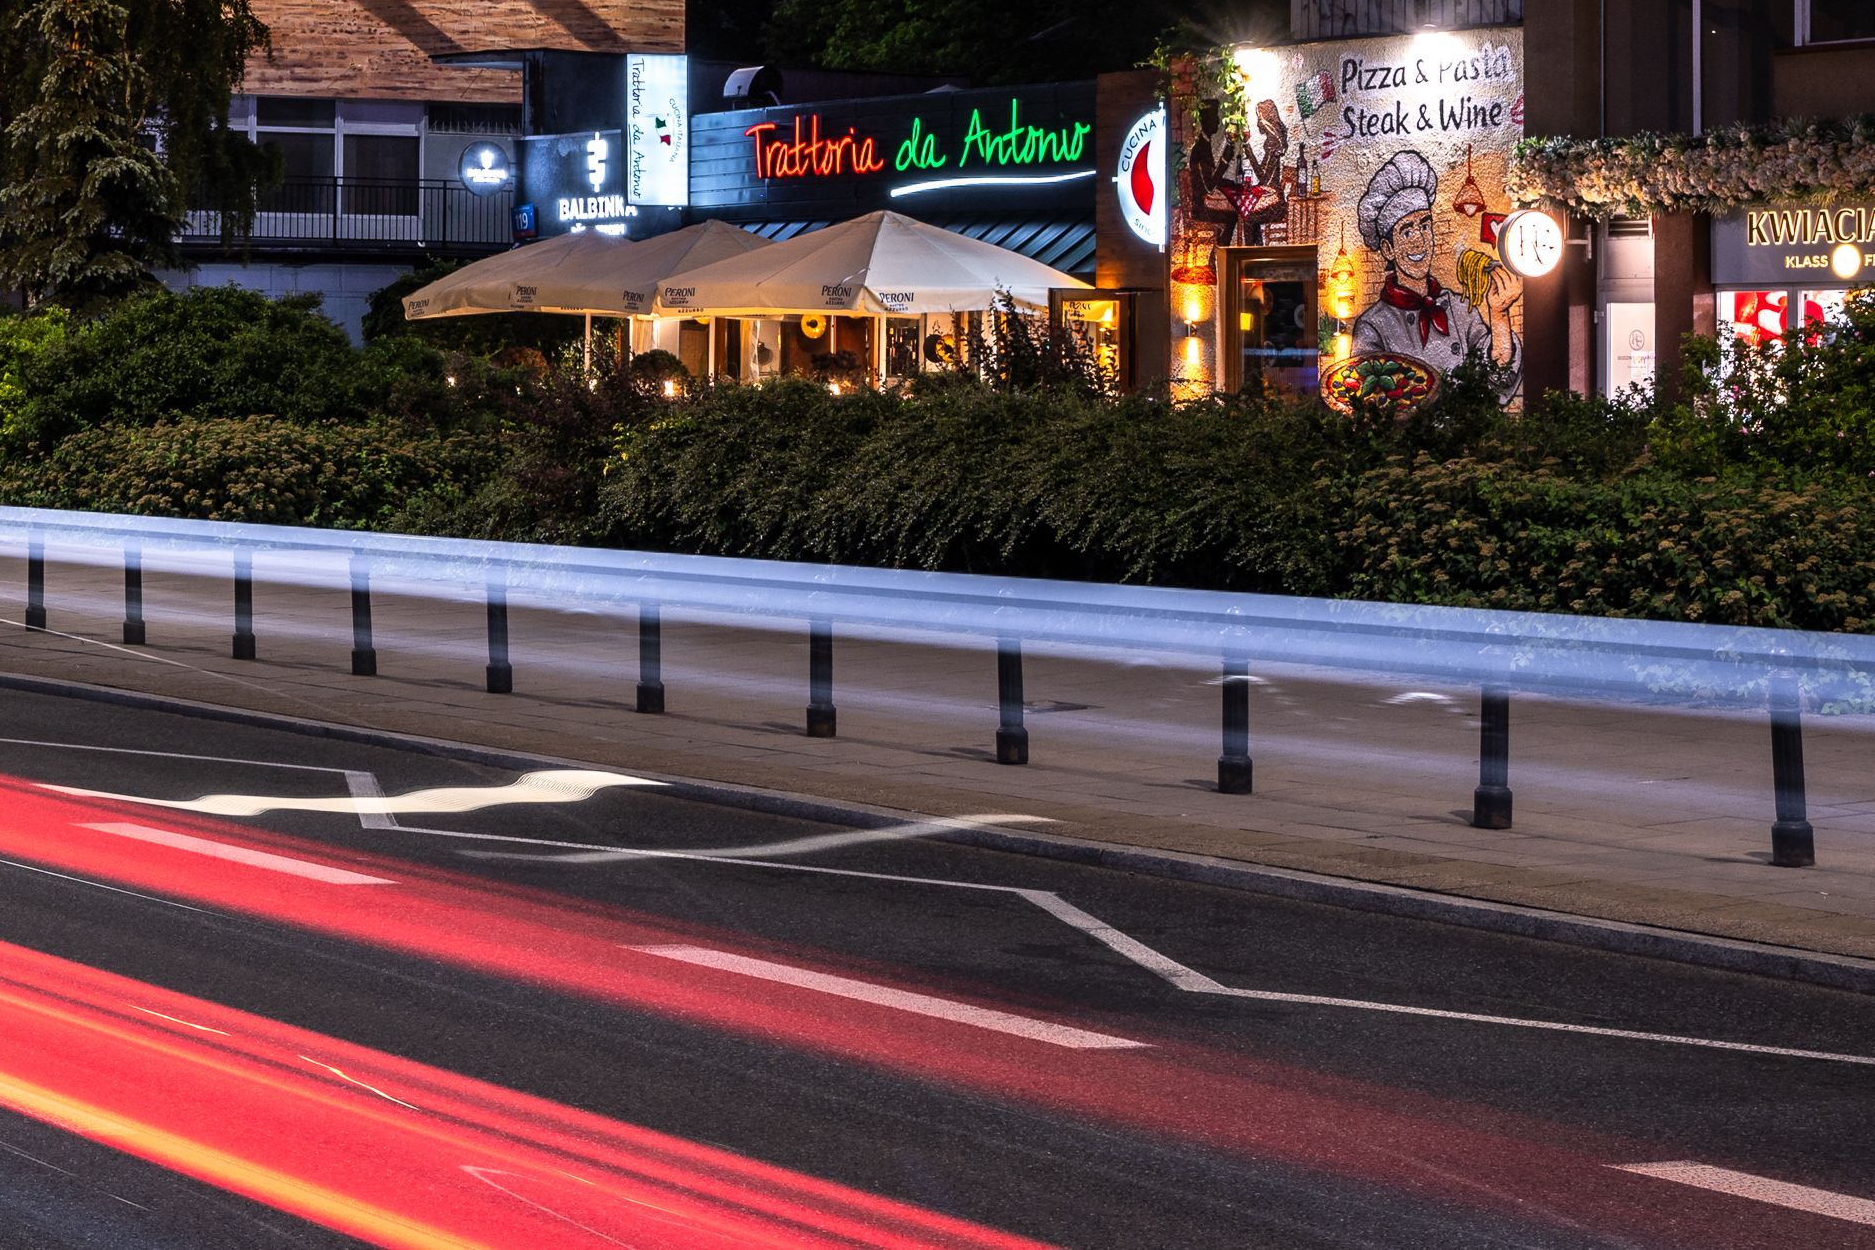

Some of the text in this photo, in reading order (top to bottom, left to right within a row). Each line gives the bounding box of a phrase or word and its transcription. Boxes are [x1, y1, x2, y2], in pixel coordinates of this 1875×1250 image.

[1341, 46, 1512, 94] Pizza & Pasta
[668, 98, 683, 131] CUCINA
[1342, 96, 1502, 139] Steak & Wine
[631, 58, 646, 199] Trattoria da Antonio
[744, 98, 1091, 179] Trattoria da Antonio
[1121, 119, 1157, 172] CUCINA
[514, 212, 529, 230] 119
[1785, 254, 1829, 269] KLASS
[516, 285, 537, 296] PERONI
[623, 290, 644, 303] PERONI
[665, 287, 695, 297] PERONI
[821, 285, 852, 297] PERONI
[879, 292, 915, 303] PERONI
